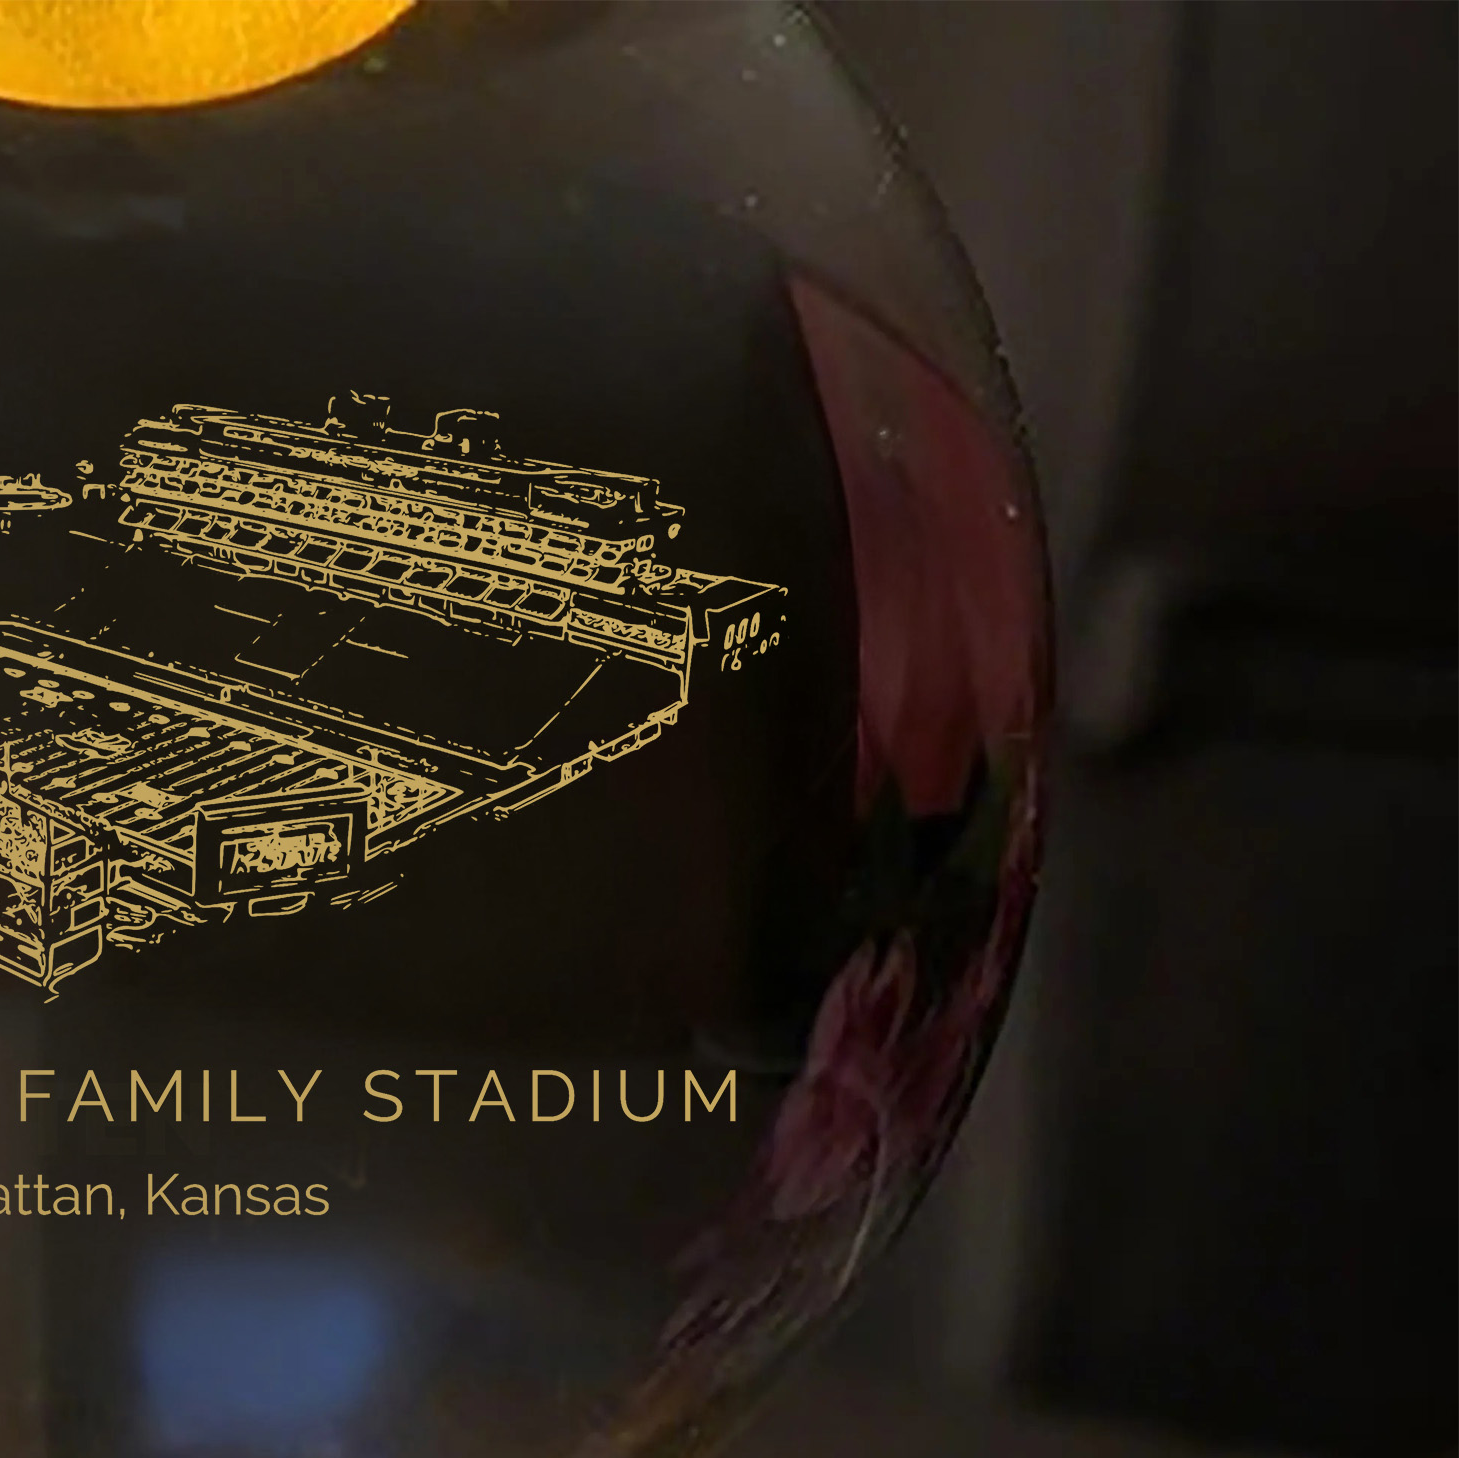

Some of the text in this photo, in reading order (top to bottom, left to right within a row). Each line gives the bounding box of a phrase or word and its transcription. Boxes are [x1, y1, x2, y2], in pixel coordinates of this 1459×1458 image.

[20, 1069, 323, 1122] FAMILY
[363, 1069, 736, 1123] STADIUM
[147, 1173, 330, 1217] Kansas
